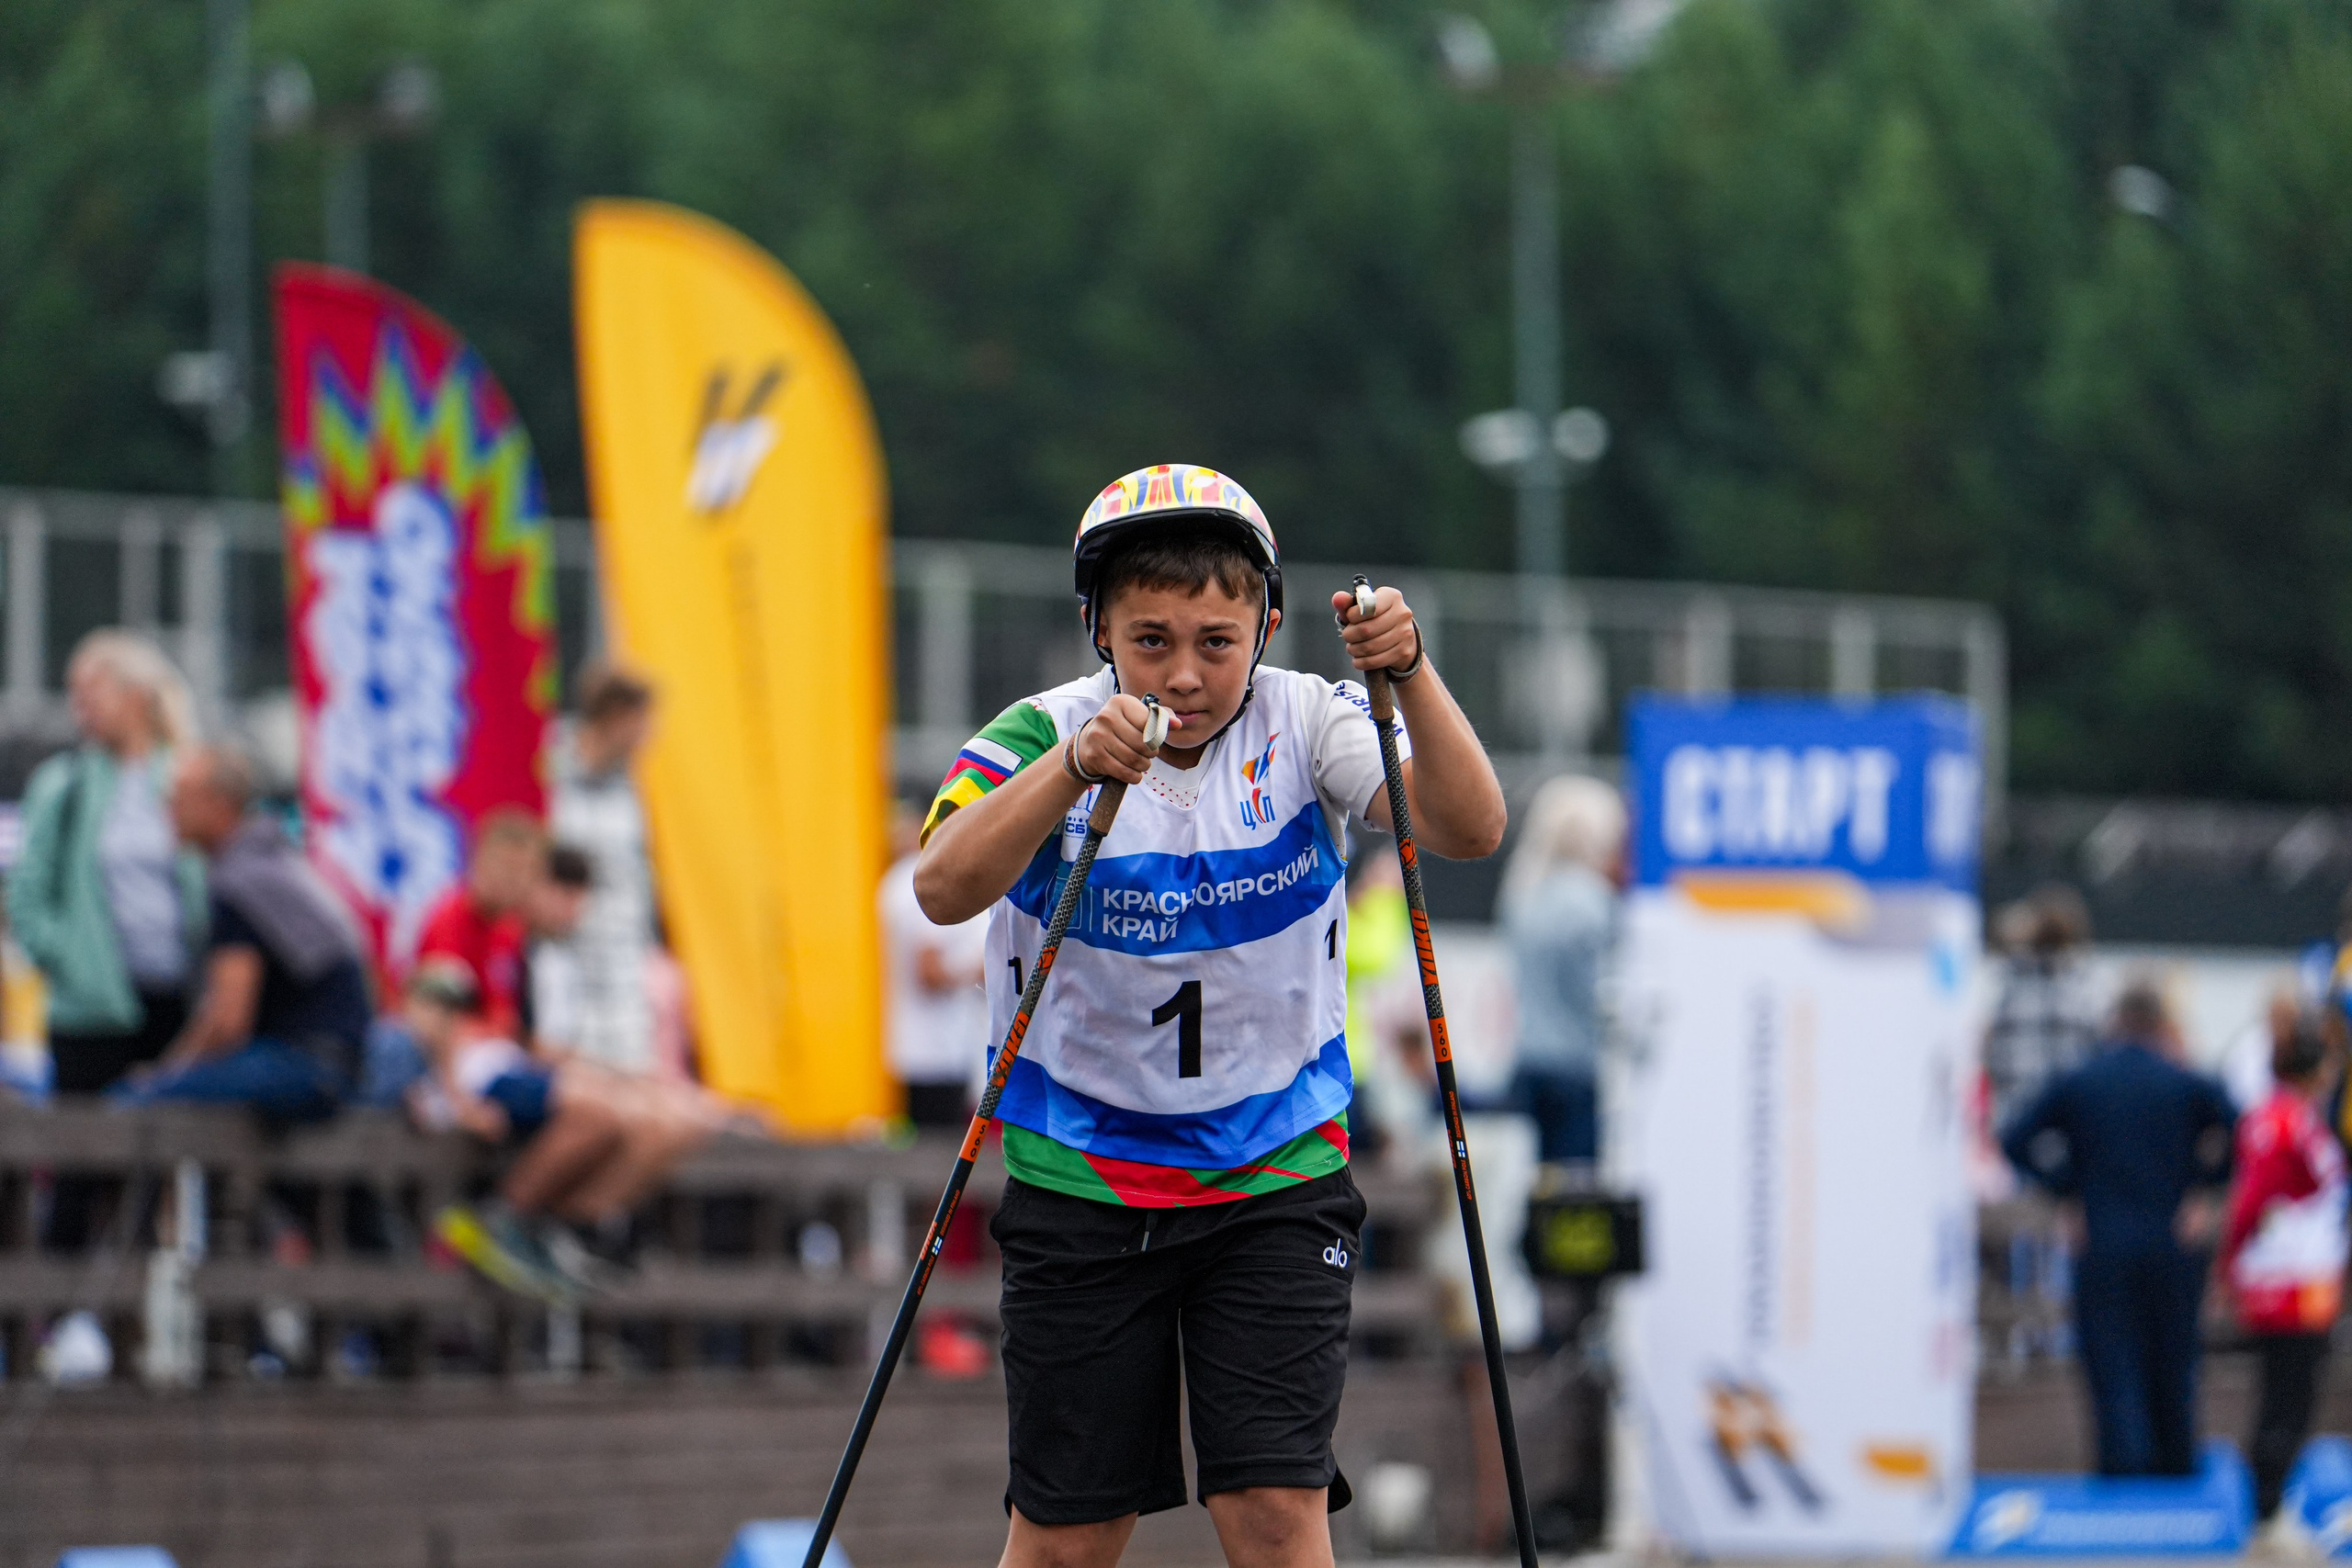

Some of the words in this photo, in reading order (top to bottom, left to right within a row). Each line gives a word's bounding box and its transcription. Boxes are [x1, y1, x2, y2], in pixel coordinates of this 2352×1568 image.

[1663, 746, 1897, 863] СТАРТ
[1102, 844, 1319, 916] КРАСНОЯРСКИЙ
[1102, 915, 1180, 942] КРАЙ
[1325, 919, 1337, 960] 1
[1008, 956, 1023, 996] 1
[1152, 980, 1203, 1078] 1
[1437, 1022, 1448, 1057] 560
[969, 1123, 987, 1158] 560
[1323, 1238, 1348, 1268] alo
